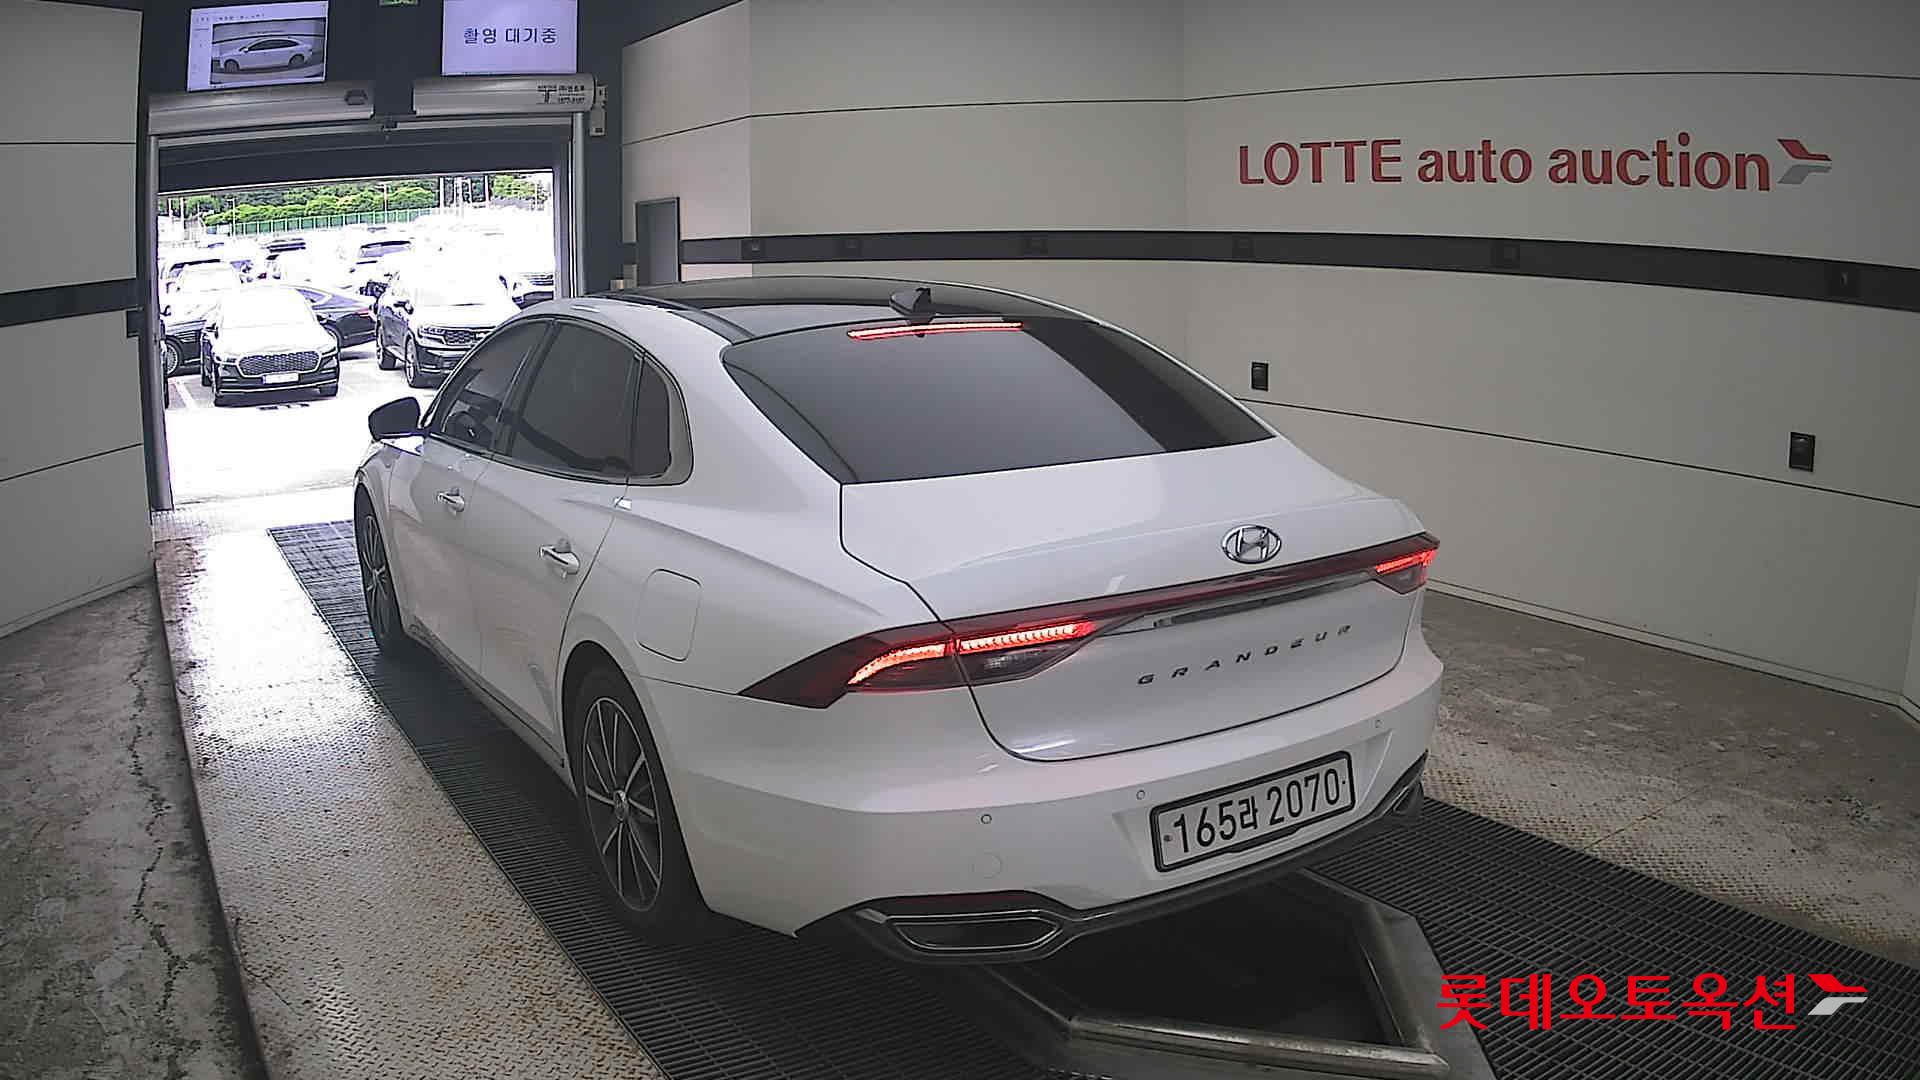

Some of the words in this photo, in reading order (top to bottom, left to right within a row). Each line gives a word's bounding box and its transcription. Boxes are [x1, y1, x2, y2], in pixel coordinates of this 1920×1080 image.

[463, 28, 497, 44] 촬영
[505, 28, 557, 44] 대기중
[1239, 138, 1402, 186] LOTTE
[1417, 139, 1533, 184] auto
[1548, 132, 1771, 192] auction
[1137, 624, 1352, 685] GRANDEUR
[1173, 795, 1258, 853] 165라
[1267, 768, 1340, 826] 2070
